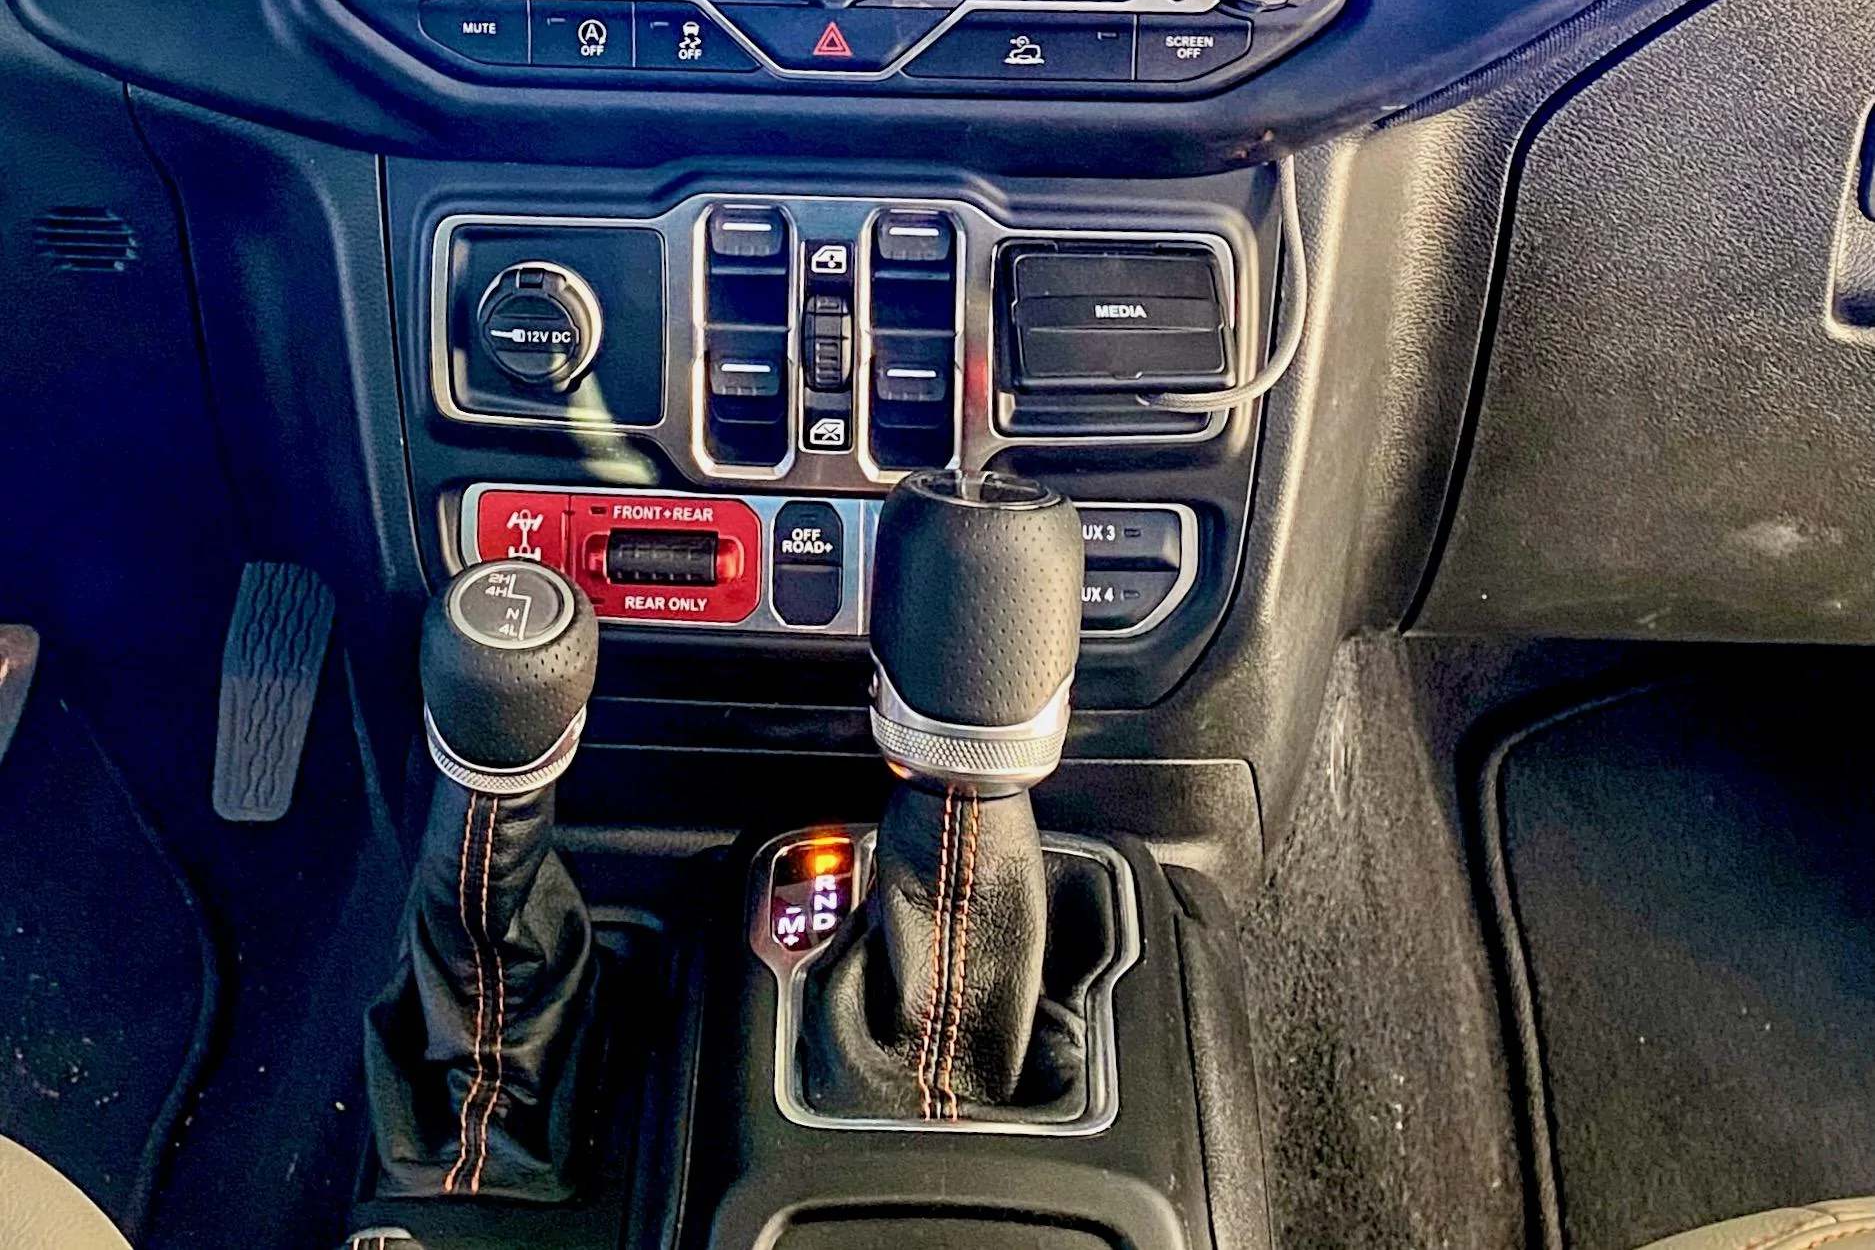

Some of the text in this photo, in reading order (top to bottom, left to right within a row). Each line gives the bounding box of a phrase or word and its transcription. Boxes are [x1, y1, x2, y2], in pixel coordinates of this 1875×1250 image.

[462, 22, 497, 35] MUTE
[1165, 35, 1214, 48] SCREEN
[580, 45, 604, 57] OFF
[678, 49, 702, 61] OFF
[1176, 47, 1201, 59] OFF
[1095, 303, 1148, 319] MEDIA
[526, 330, 572, 344] 12V DC
[791, 528, 821, 541] OFF
[1082, 524, 1116, 541] UX 3
[488, 573, 510, 585] 2H
[484, 585, 508, 598] 4H
[1081, 586, 1115, 602] UX 4
[624, 596, 708, 612] REAR ONLY
[505, 607, 520, 621] N
[498, 623, 518, 637] 4L
[815, 854, 838, 874] P
[815, 874, 836, 892] R
[813, 892, 838, 911] N
[777, 915, 806, 935] M
[812, 912, 837, 931] D
